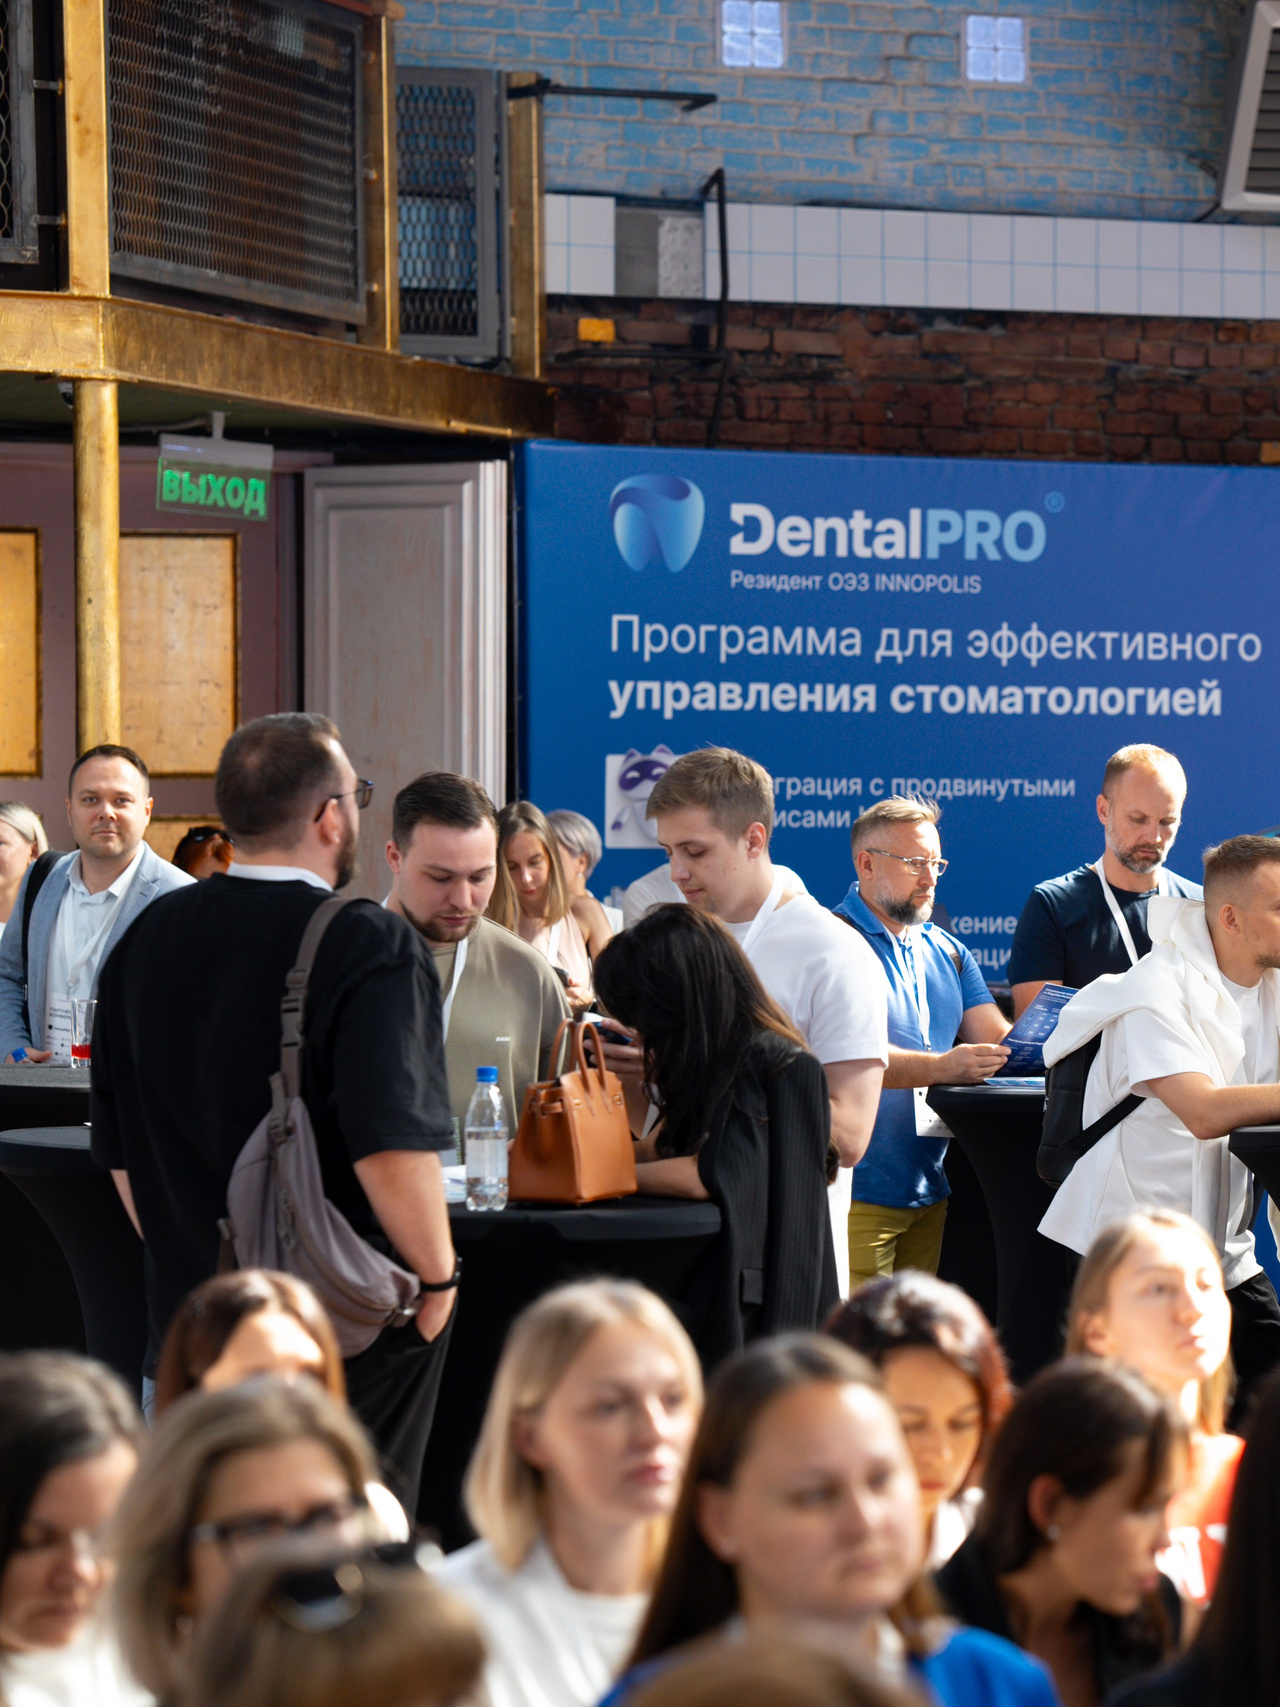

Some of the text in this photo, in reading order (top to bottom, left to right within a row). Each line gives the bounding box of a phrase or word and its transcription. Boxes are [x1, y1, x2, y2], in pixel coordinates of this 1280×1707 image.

[162, 469, 267, 517] ВЫХОД
[730, 570, 983, 595] Резидент ОЭЗ INNOPOLIS
[610, 613, 1263, 668] Программа для эффективного
[607, 679, 1223, 720] управления стоматологией
[774, 776, 1077, 802] грация с продвинутыми
[772, 809, 851, 829] исами
